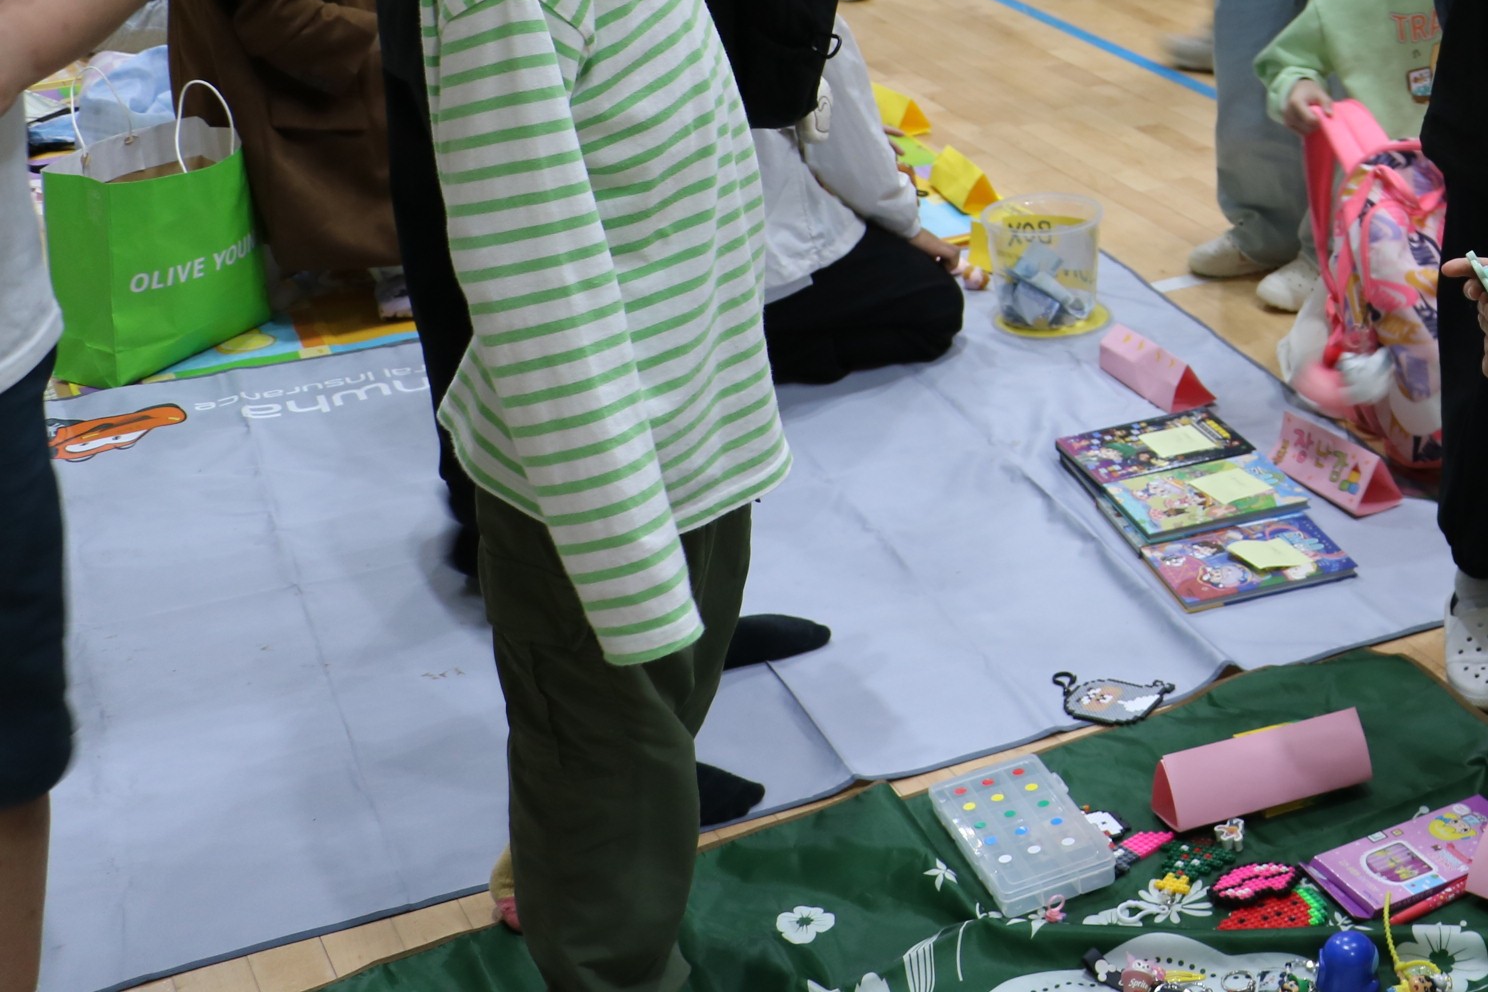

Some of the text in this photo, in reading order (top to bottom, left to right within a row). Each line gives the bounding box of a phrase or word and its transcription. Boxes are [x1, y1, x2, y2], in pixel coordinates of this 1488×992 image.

[1391, 9, 1441, 42] TRA
[129, 230, 256, 293] OLIVE YOUN
[383, 364, 426, 378] ral
[240, 376, 430, 419] nwha
[1293, 428, 1349, 483] 장난감
